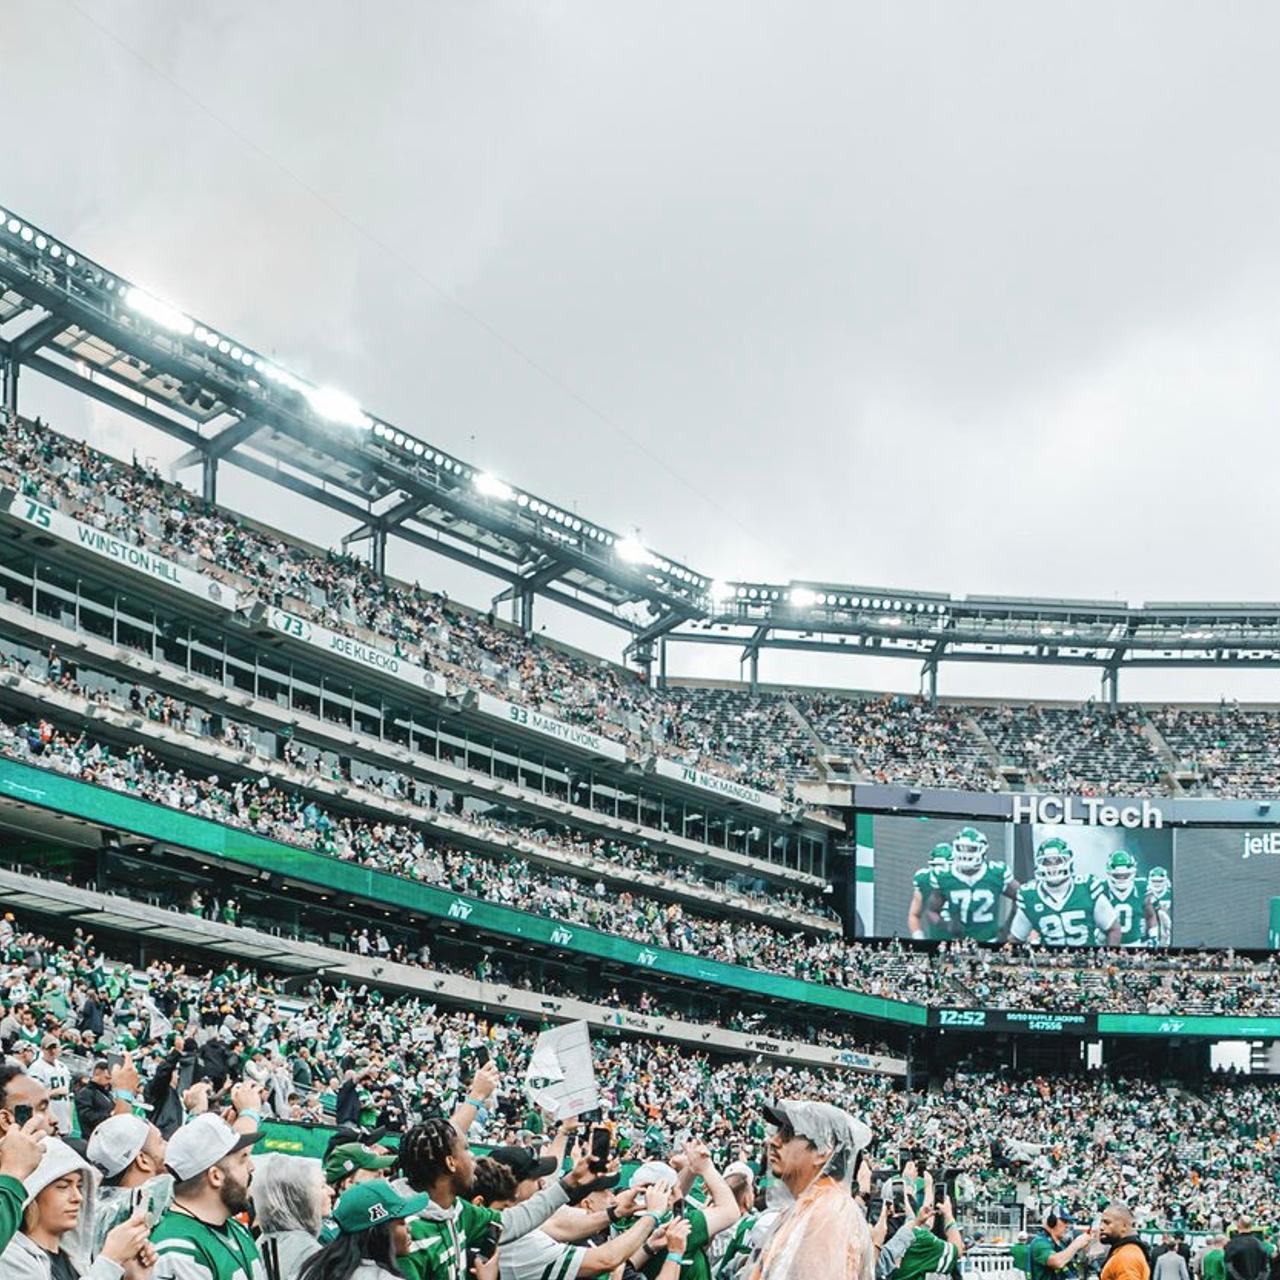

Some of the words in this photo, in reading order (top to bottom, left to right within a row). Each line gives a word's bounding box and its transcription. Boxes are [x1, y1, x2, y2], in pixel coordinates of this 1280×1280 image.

[24, 500, 52, 528] 75
[78, 526, 150, 570] WINSTON
[151, 558, 182, 584] HILL
[282, 614, 303, 638] 73
[329, 636, 353, 656] JOE
[354, 646, 399, 673] KLECKO
[510, 706, 529, 725] 93
[533, 715, 570, 740] MARTY
[570, 727, 600, 750] LYONS
[681, 768, 696, 784] 74
[699, 774, 720, 792] NICK
[720, 781, 761, 804] MANGOLD
[1011, 795, 1163, 829] HCLTech
[448, 899, 473, 920] NY
[950, 889, 995, 924] 72
[550, 926, 573, 945] NY
[1038, 909, 1089, 946] 95
[637, 948, 657, 966] NY
[939, 1010, 986, 1026] 12:52
